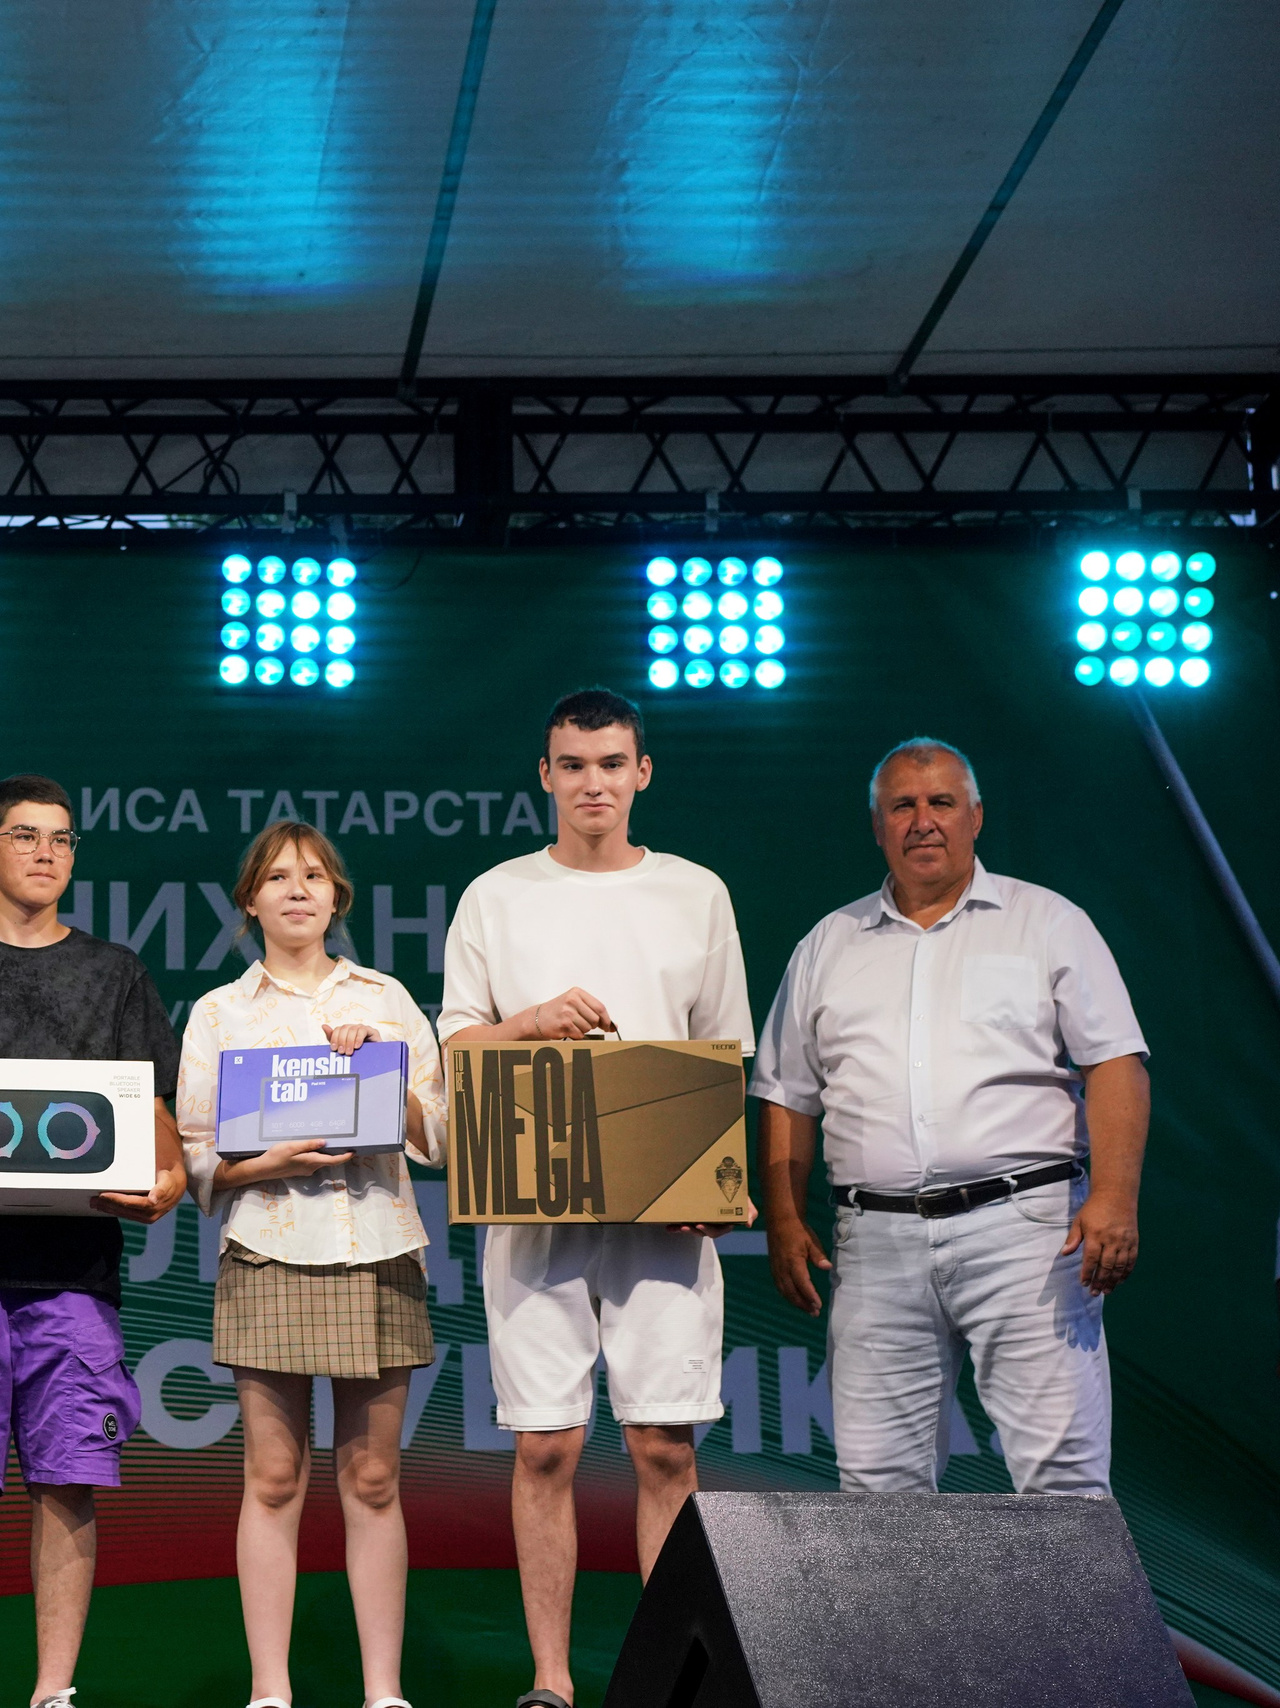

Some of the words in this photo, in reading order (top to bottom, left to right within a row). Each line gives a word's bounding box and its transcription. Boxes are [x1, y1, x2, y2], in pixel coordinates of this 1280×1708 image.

[80, 788, 210, 833] ИСА
[271, 1051, 352, 1079] kenshi
[270, 1078, 309, 1103] tab
[453, 1046, 606, 1218] MEGA
